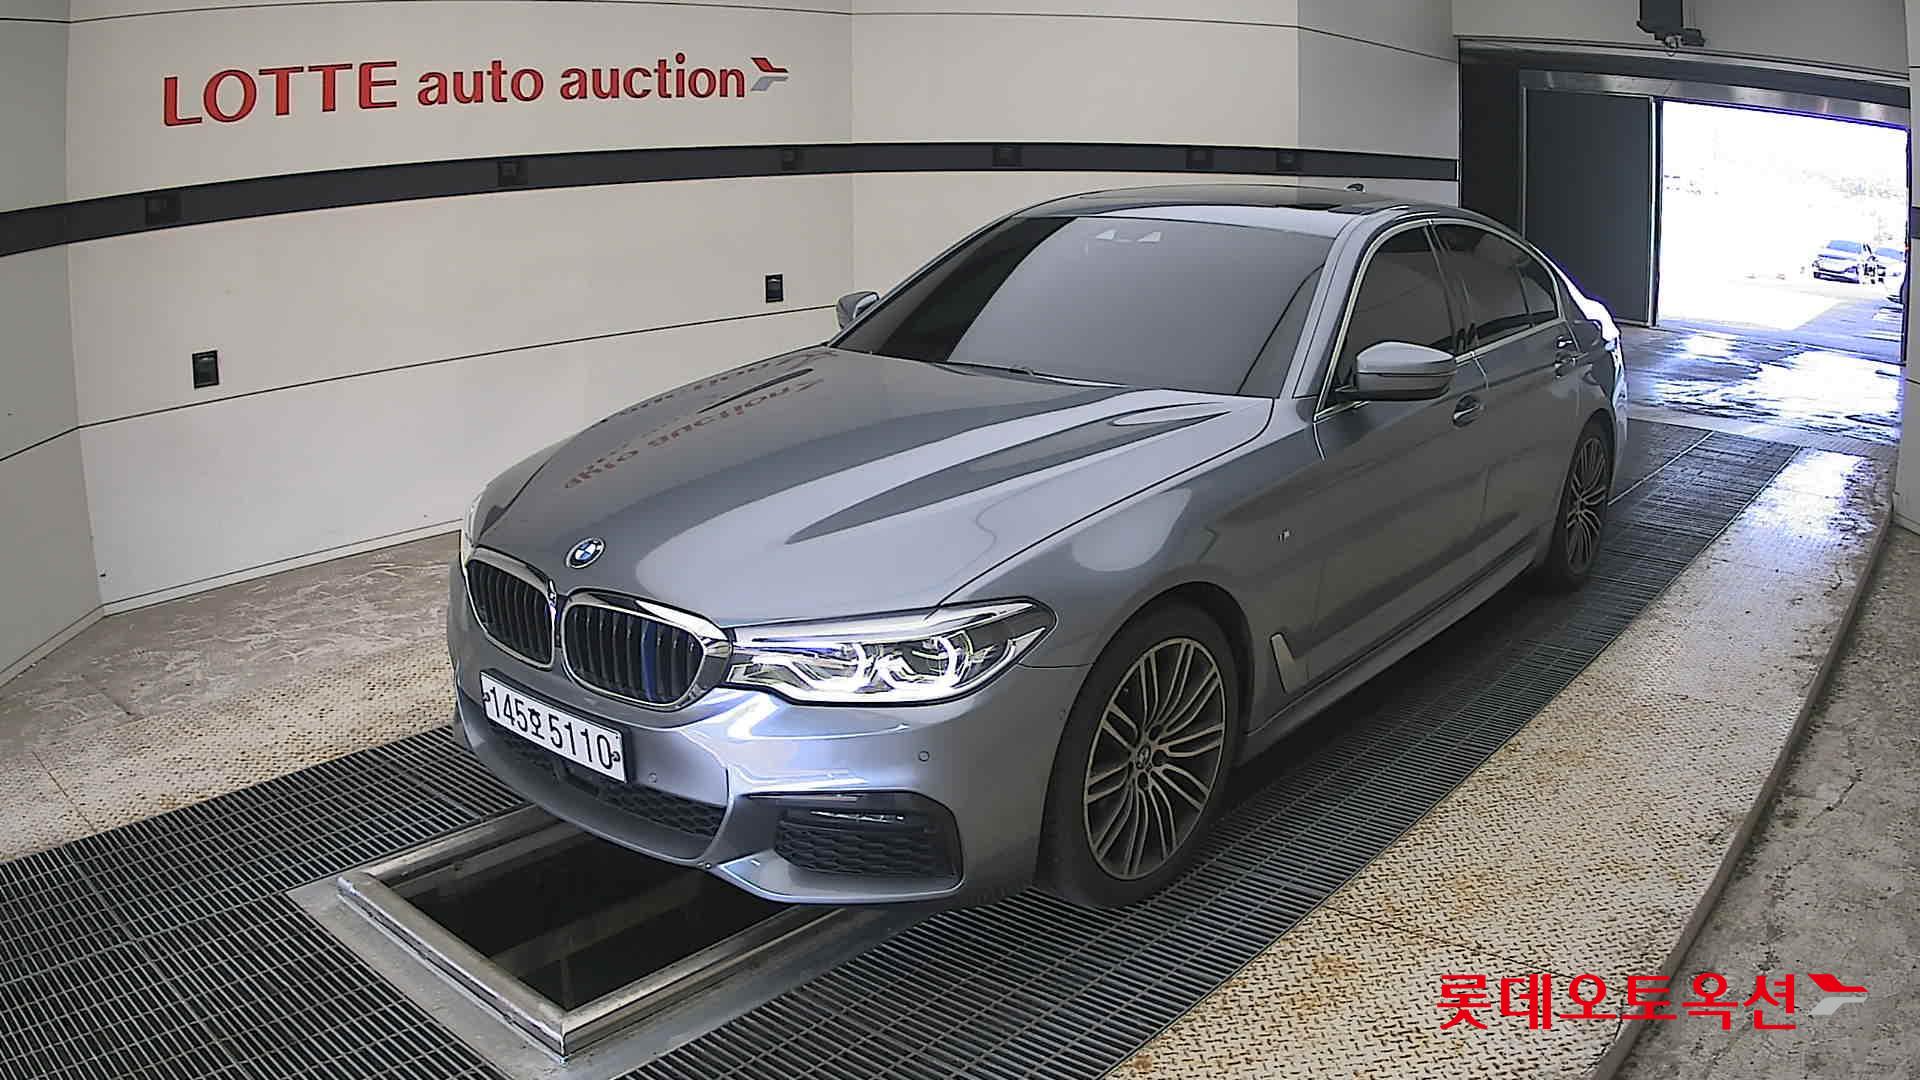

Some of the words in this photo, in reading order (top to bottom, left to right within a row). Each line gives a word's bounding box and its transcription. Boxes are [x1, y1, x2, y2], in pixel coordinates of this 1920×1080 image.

[163, 60, 398, 127] LOTTE
[416, 60, 544, 106] auto
[560, 53, 747, 101] auction
[490, 686, 545, 739] 145호
[548, 712, 614, 770] 5110
